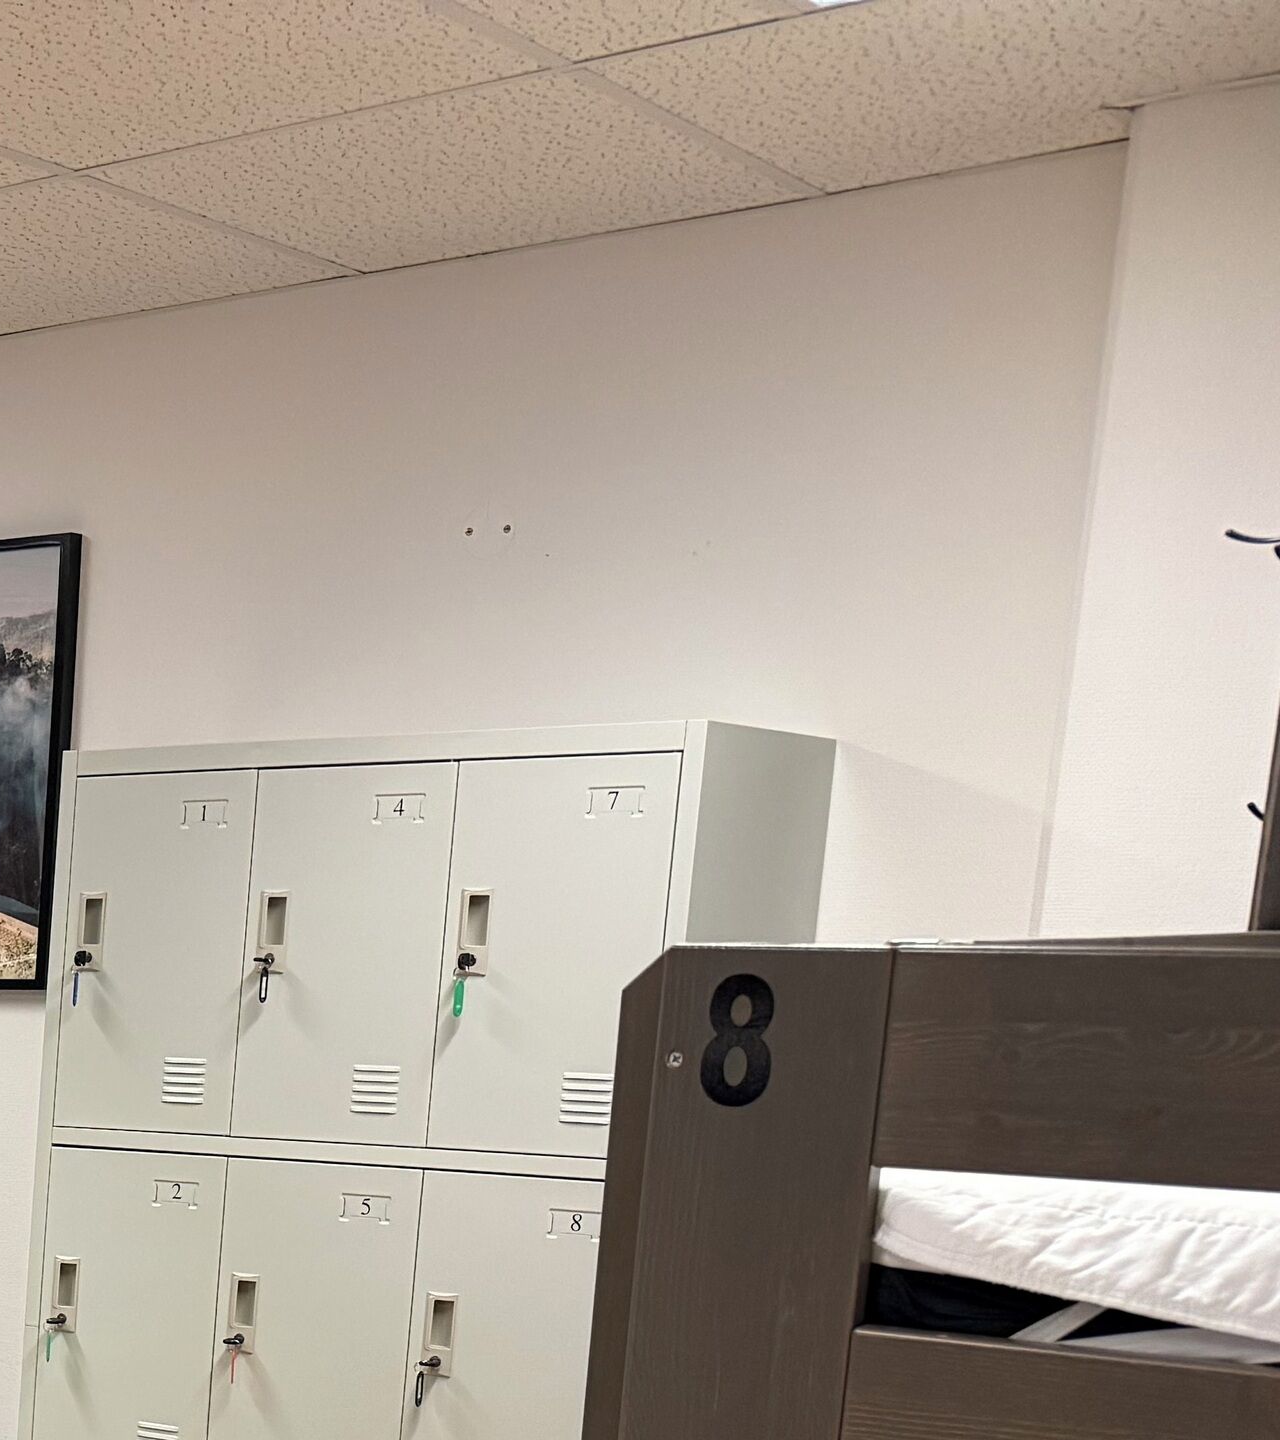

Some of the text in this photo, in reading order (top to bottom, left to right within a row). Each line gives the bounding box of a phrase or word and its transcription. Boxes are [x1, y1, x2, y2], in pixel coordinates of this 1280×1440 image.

[393, 797, 405, 817] 4
[607, 791, 618, 810] 7
[201, 805, 207, 822] 1
[700, 973, 775, 1107] 8
[172, 1183, 182, 1200] 2
[361, 1197, 372, 1216] 5
[570, 1213, 582, 1232] 8
